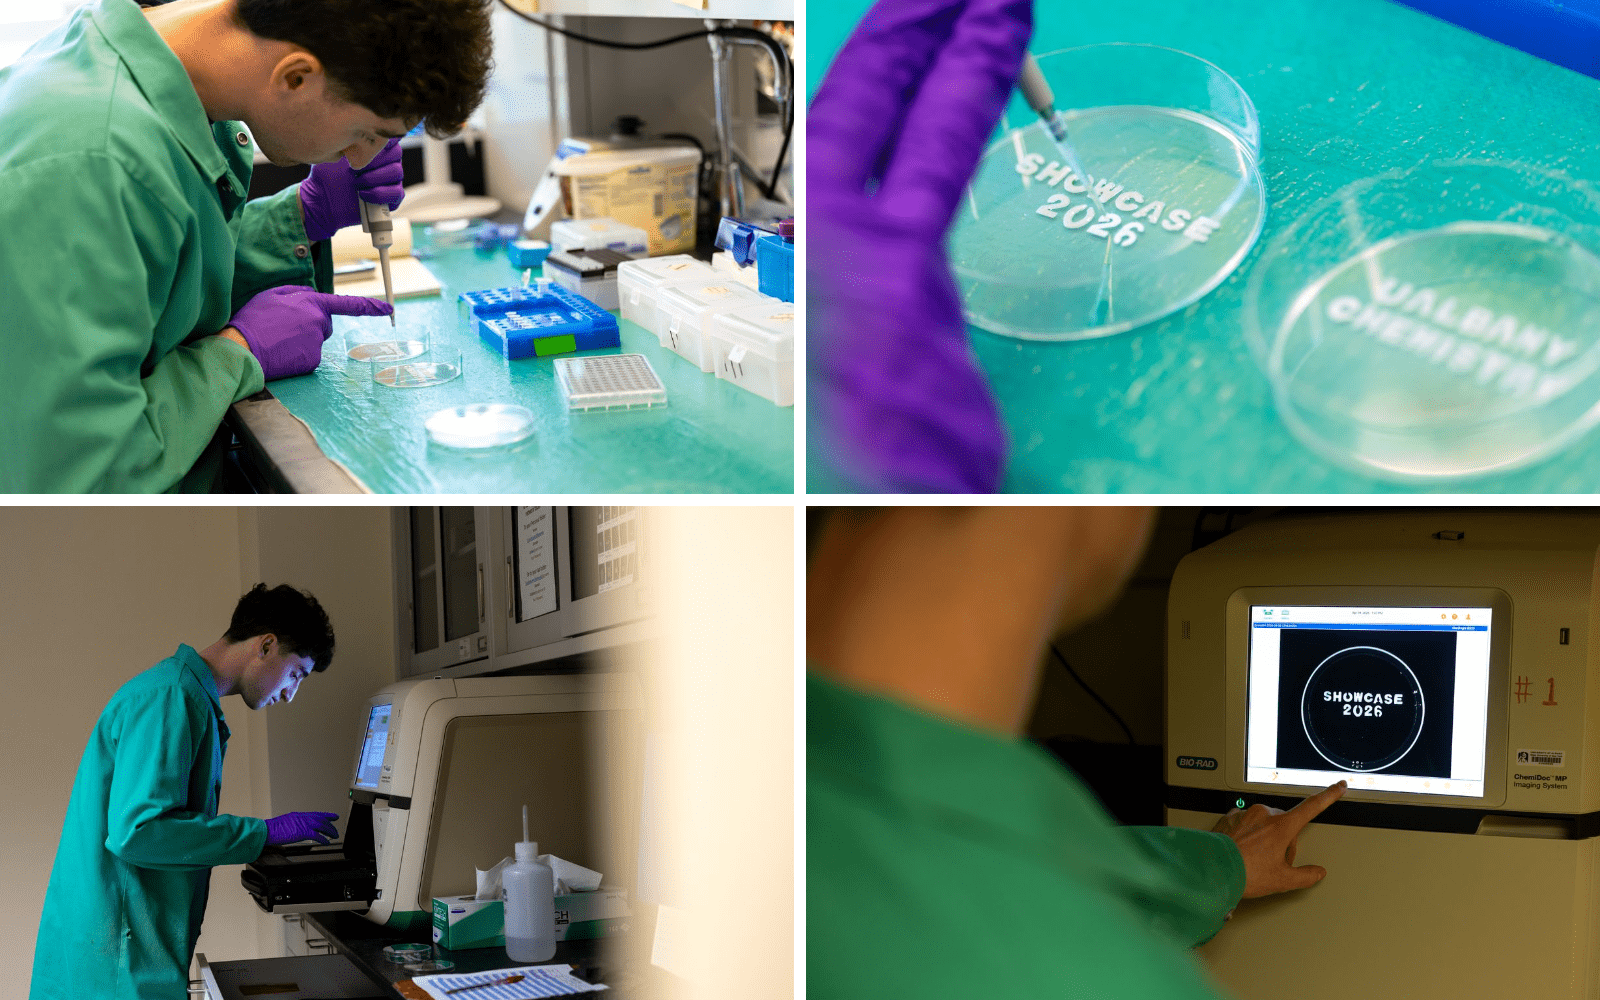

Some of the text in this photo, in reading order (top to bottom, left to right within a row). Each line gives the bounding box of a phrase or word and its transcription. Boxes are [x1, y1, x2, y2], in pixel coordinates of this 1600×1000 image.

[1015, 153, 1221, 243] SHOWCASE
[1035, 193, 1145, 247] 2026
[1374, 277, 1577, 366] UALBANY
[1327, 295, 1573, 399] CHEMISTRY
[1323, 691, 1404, 705] SHOWCASE
[1343, 703, 1383, 718] 2026
[1513, 781, 1568, 790] Imaging System
[554, 910, 569, 920] CH
